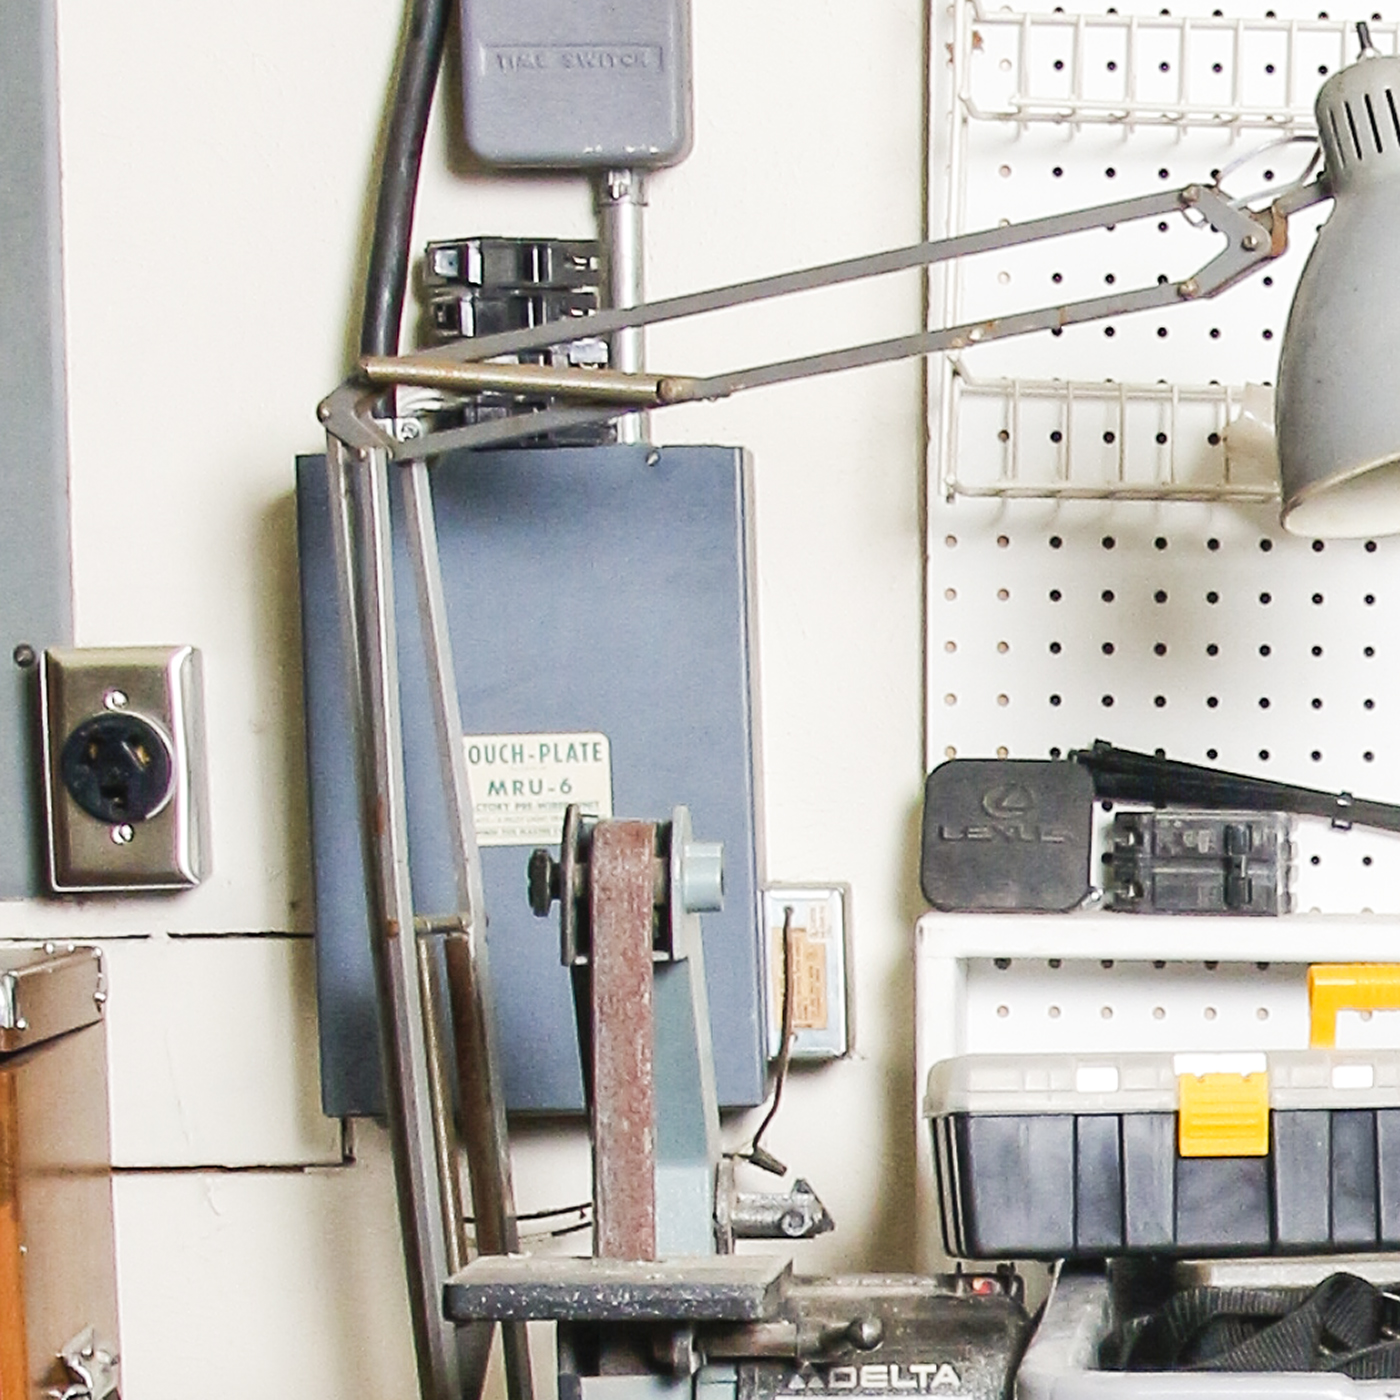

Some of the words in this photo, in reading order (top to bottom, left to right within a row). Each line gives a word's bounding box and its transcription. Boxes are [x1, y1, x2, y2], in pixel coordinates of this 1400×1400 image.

[468, 741, 603, 765] OUCH-PLATE
[487, 777, 573, 797] MRU-6
[827, 1362, 963, 1390] DELTA
